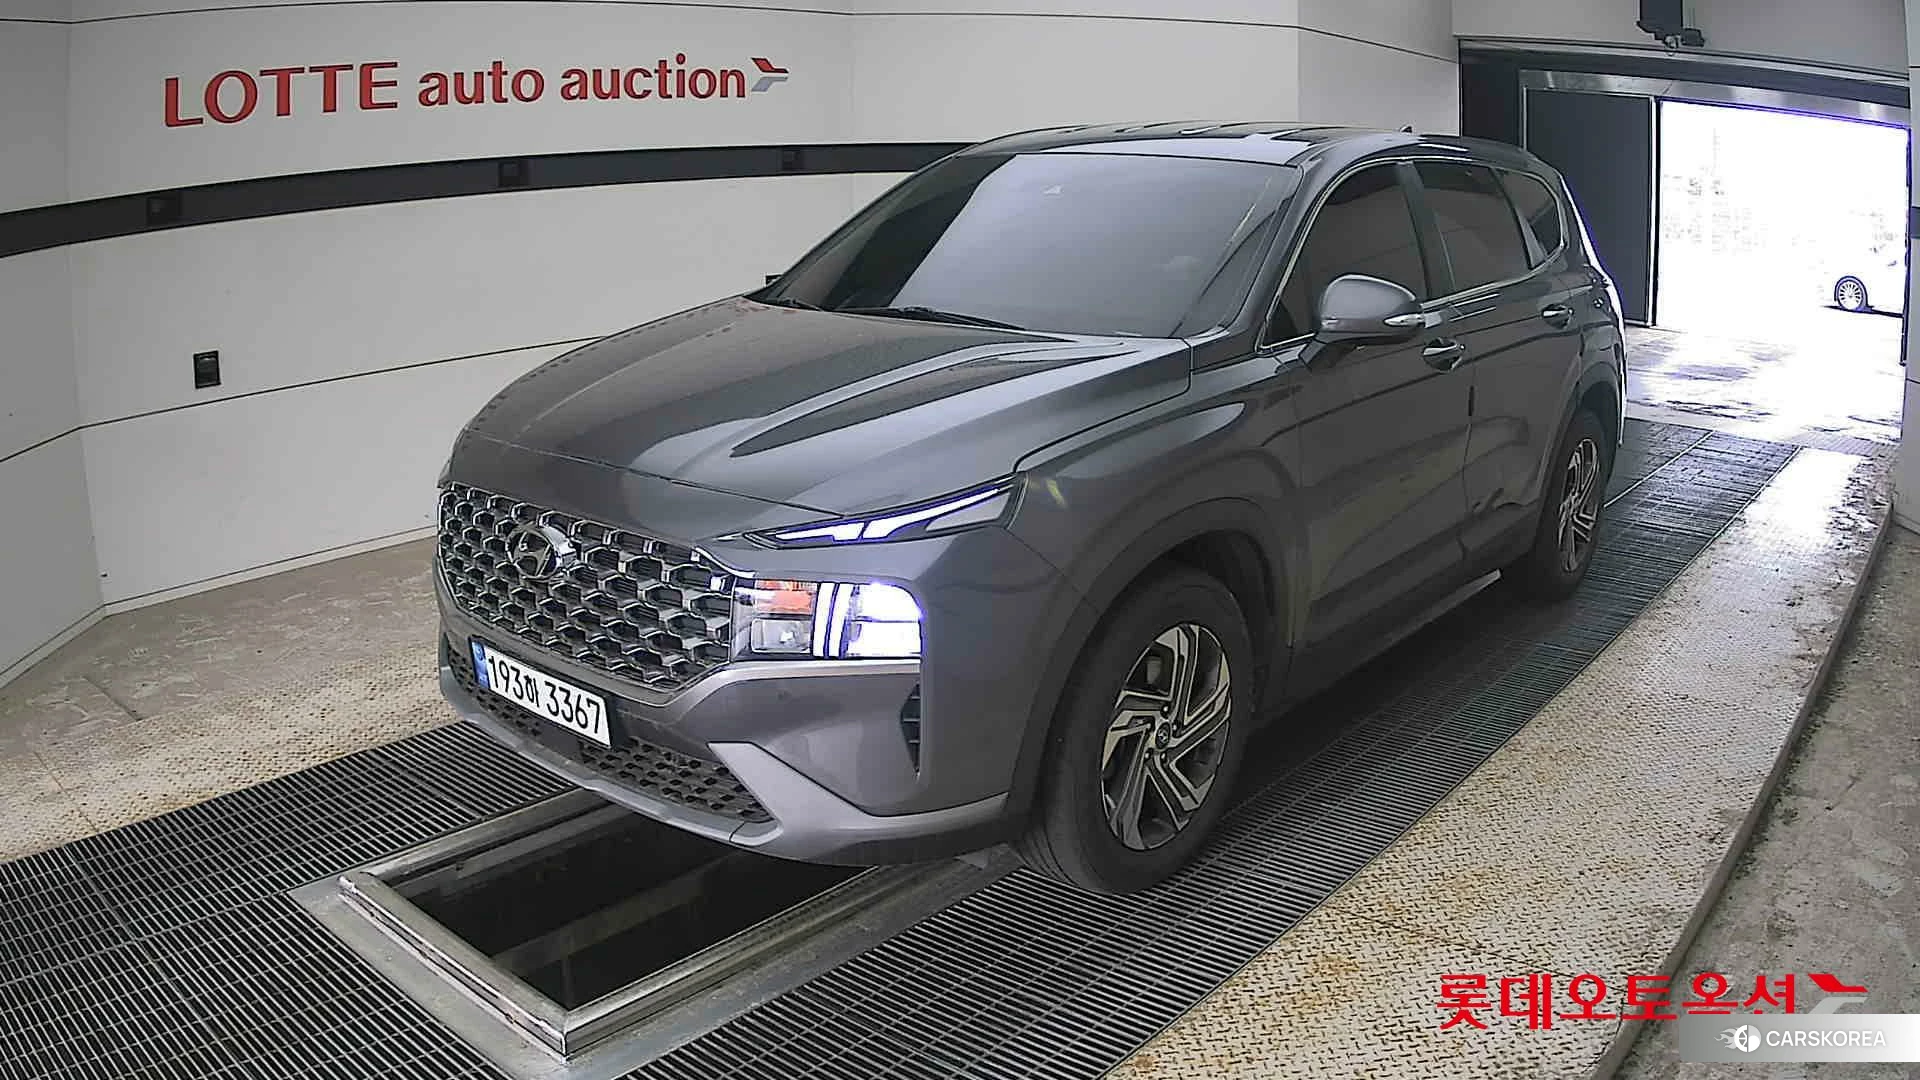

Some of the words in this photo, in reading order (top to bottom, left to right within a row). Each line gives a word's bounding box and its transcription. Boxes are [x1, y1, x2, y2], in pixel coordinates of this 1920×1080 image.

[165, 61, 398, 127] LOTTE
[418, 61, 545, 103] auto
[560, 53, 746, 100] auction
[488, 656, 539, 708] 193하
[544, 681, 600, 734] 3367
